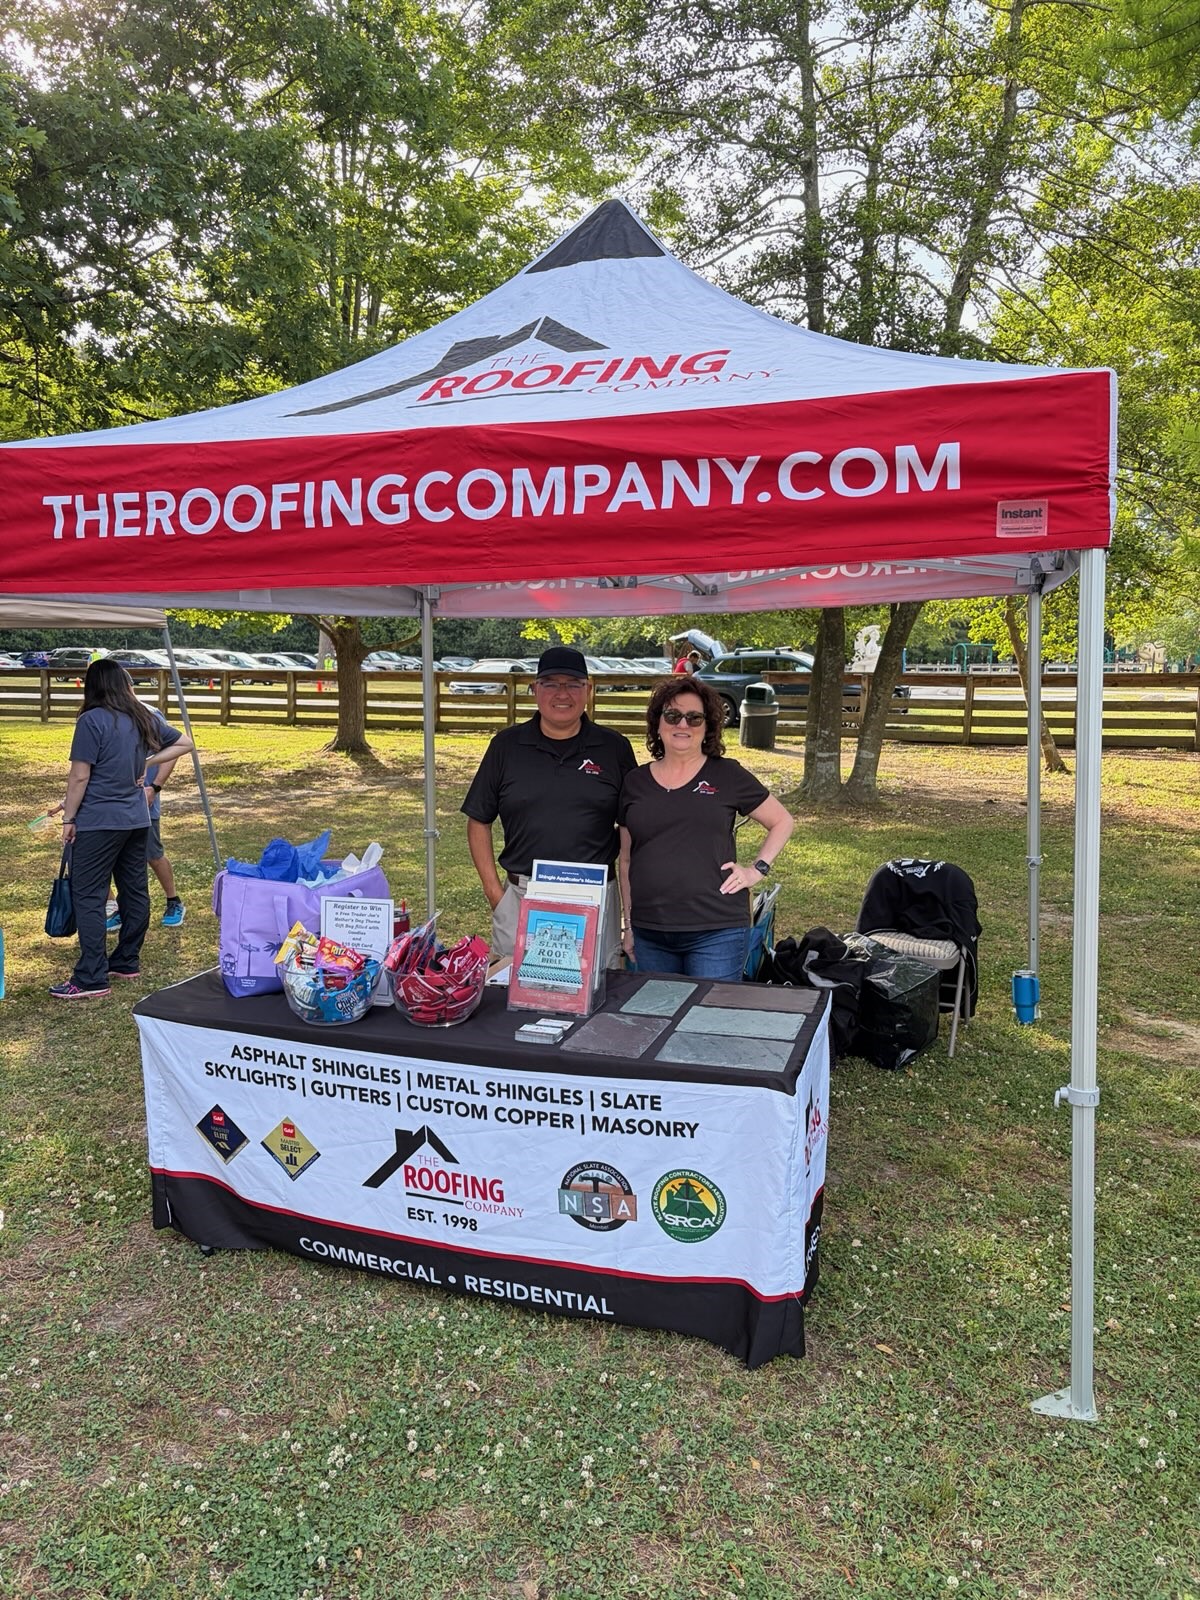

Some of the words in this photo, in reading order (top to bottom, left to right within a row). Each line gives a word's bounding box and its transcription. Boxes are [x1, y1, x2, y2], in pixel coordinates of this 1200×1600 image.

[490, 352, 550, 370] THE
[416, 349, 731, 402] ROOFING
[586, 368, 784, 394] COMPANY
[42, 441, 961, 540] THEROOFINGCOMPANY.COM
[1001, 507, 1043, 519] Instant
[333, 903, 359, 911] Register
[537, 949, 568, 958] ROOF
[539, 941, 571, 950] SLATE
[230, 1044, 306, 1070] ASPHALT
[312, 1057, 401, 1085] SHINGLES
[417, 1072, 481, 1097] METAL
[485, 1081, 584, 1106] SHINGLES
[601, 1091, 662, 1112] SLATE
[205, 1061, 296, 1091] SKYLIGHTS
[311, 1080, 391, 1107] GUTTERS
[406, 1095, 488, 1121] CUSTOM
[494, 1106, 575, 1130] COPPER
[592, 1115, 700, 1139] MASONRY
[213, 1131, 229, 1141] ELITE
[280, 1145, 301, 1154] SELECT
[417, 1154, 439, 1168] THE
[403, 1164, 505, 1203] ROOFING
[564, 1166, 582, 1186] NATIONAL
[600, 1164, 629, 1191] ASSOCIATION
[668, 1171, 714, 1190] CONTRACTORS
[653, 1175, 669, 1201] ROOFING
[464, 1200, 524, 1218] COMPANY
[653, 1201, 663, 1221] SLATE
[712, 1188, 725, 1225] ASSOCIATION
[407, 1207, 437, 1224] EST.
[442, 1213, 478, 1232] 1998
[664, 1213, 716, 1228] SRCA
[299, 1236, 442, 1285] COMMERCIAL
[464, 1273, 615, 1316] RESIDENTIAL
